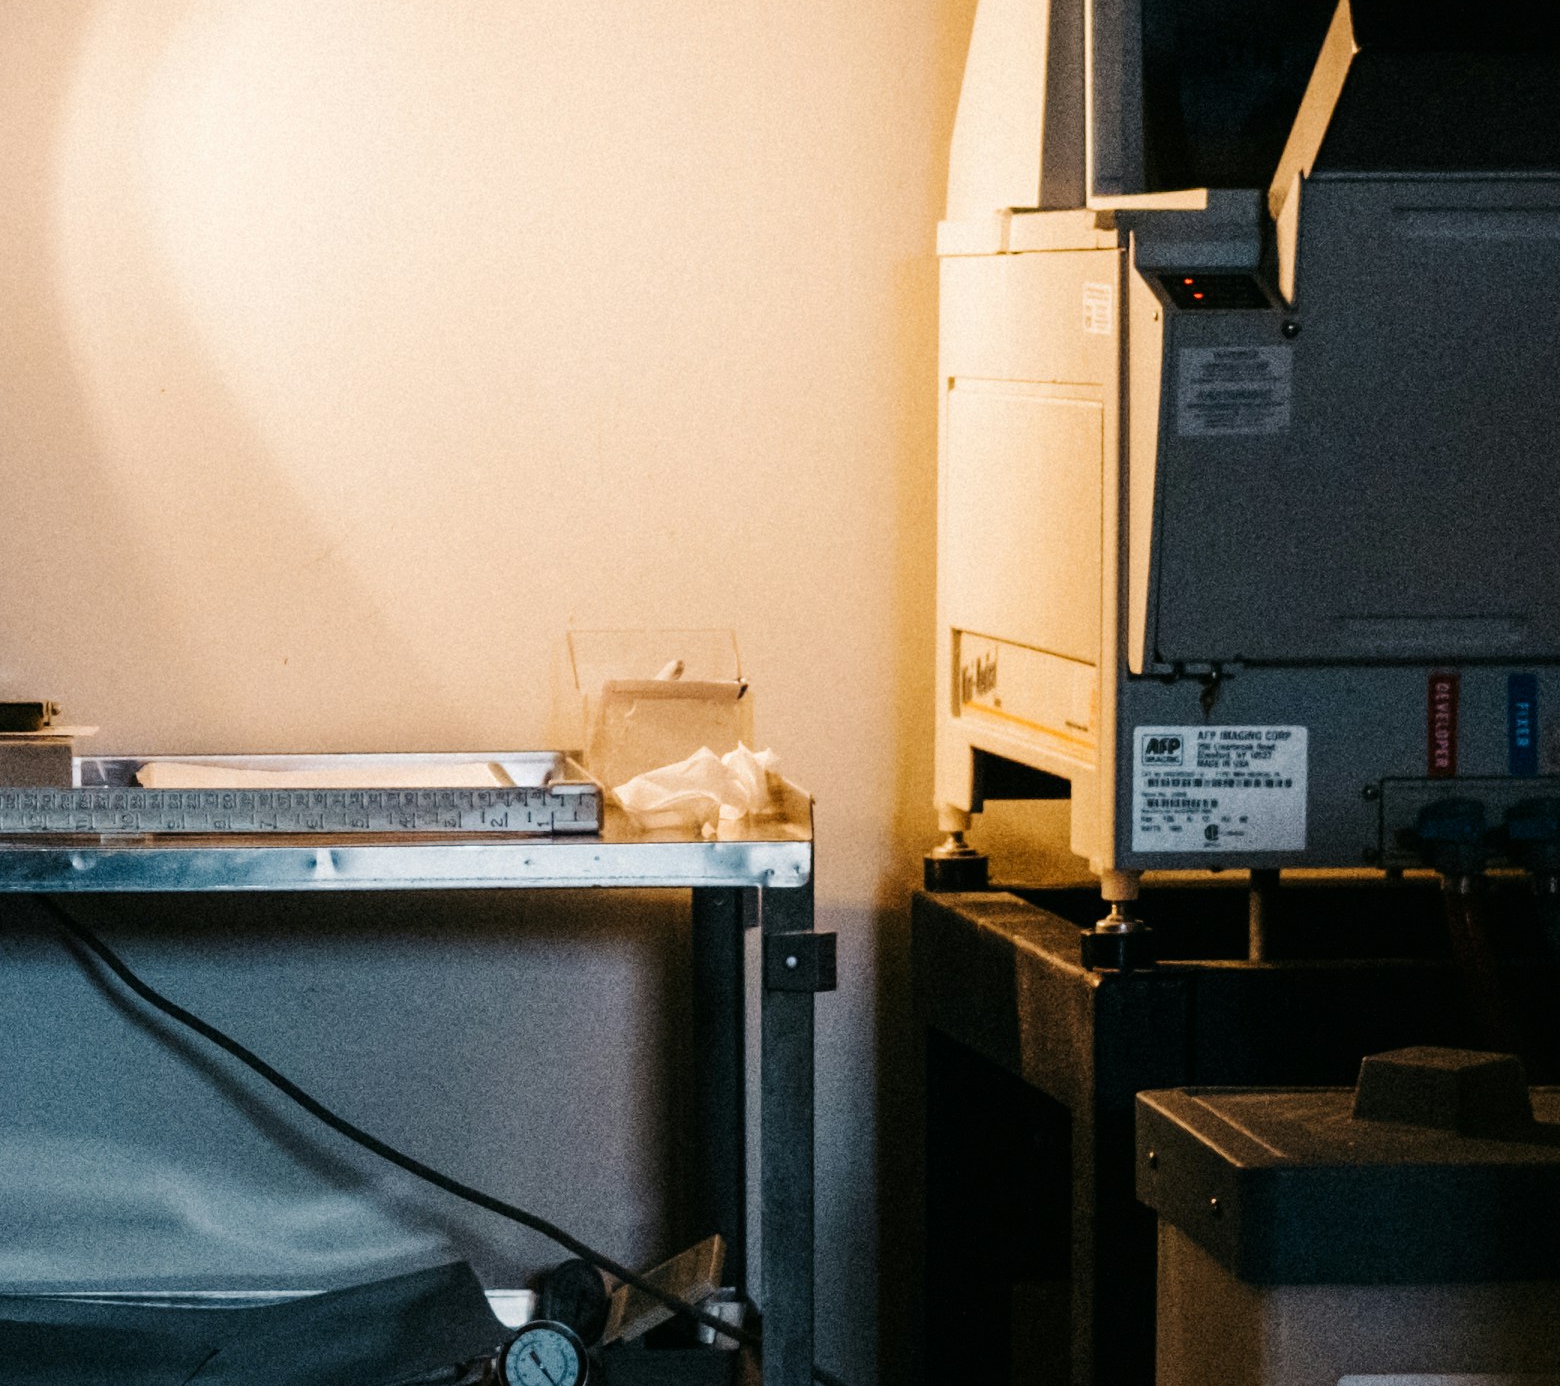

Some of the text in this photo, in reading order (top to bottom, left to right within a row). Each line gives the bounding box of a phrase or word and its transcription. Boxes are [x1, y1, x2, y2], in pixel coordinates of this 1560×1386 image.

[1197, 731, 1291, 741] AFP IMAGING CORP
[1434, 681, 1451, 769] DEVELOPER
[1514, 701, 1531, 748] FIXER
[1146, 737, 1180, 755] AFP
